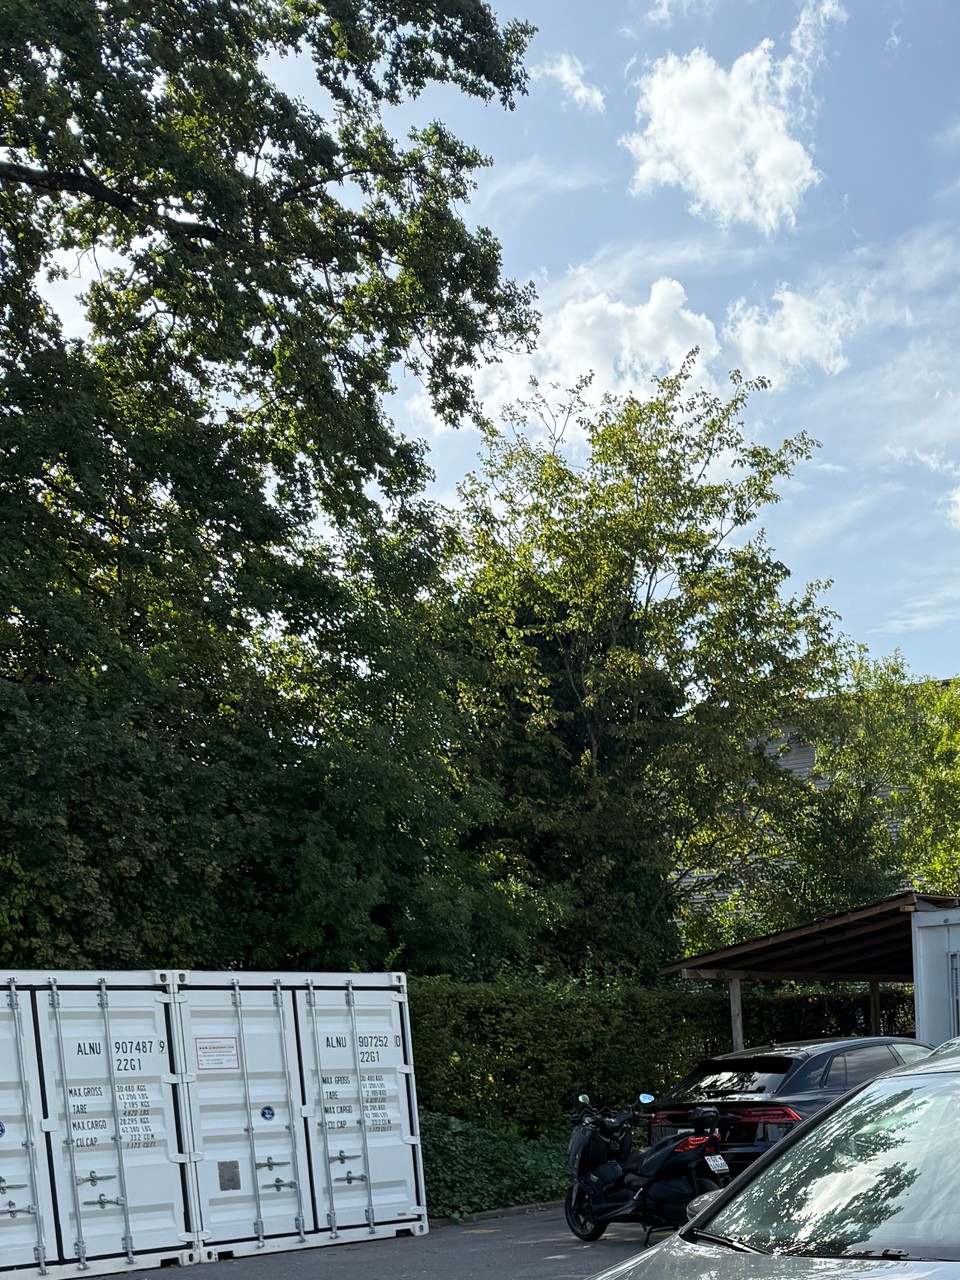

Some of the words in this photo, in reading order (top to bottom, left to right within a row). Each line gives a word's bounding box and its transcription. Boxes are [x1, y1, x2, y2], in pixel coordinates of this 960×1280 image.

[326, 1037, 346, 1048] ALNU
[359, 1036, 388, 1047] 907252
[77, 1043, 101, 1055] ALNU
[115, 1041, 153, 1054] 907487
[160, 1041, 165, 1052] 9
[360, 1052, 380, 1062] 22G1
[117, 1059, 142, 1071] 22G1
[326, 1091, 338, 1099] TARE
[73, 1104, 87, 1114] TARE
